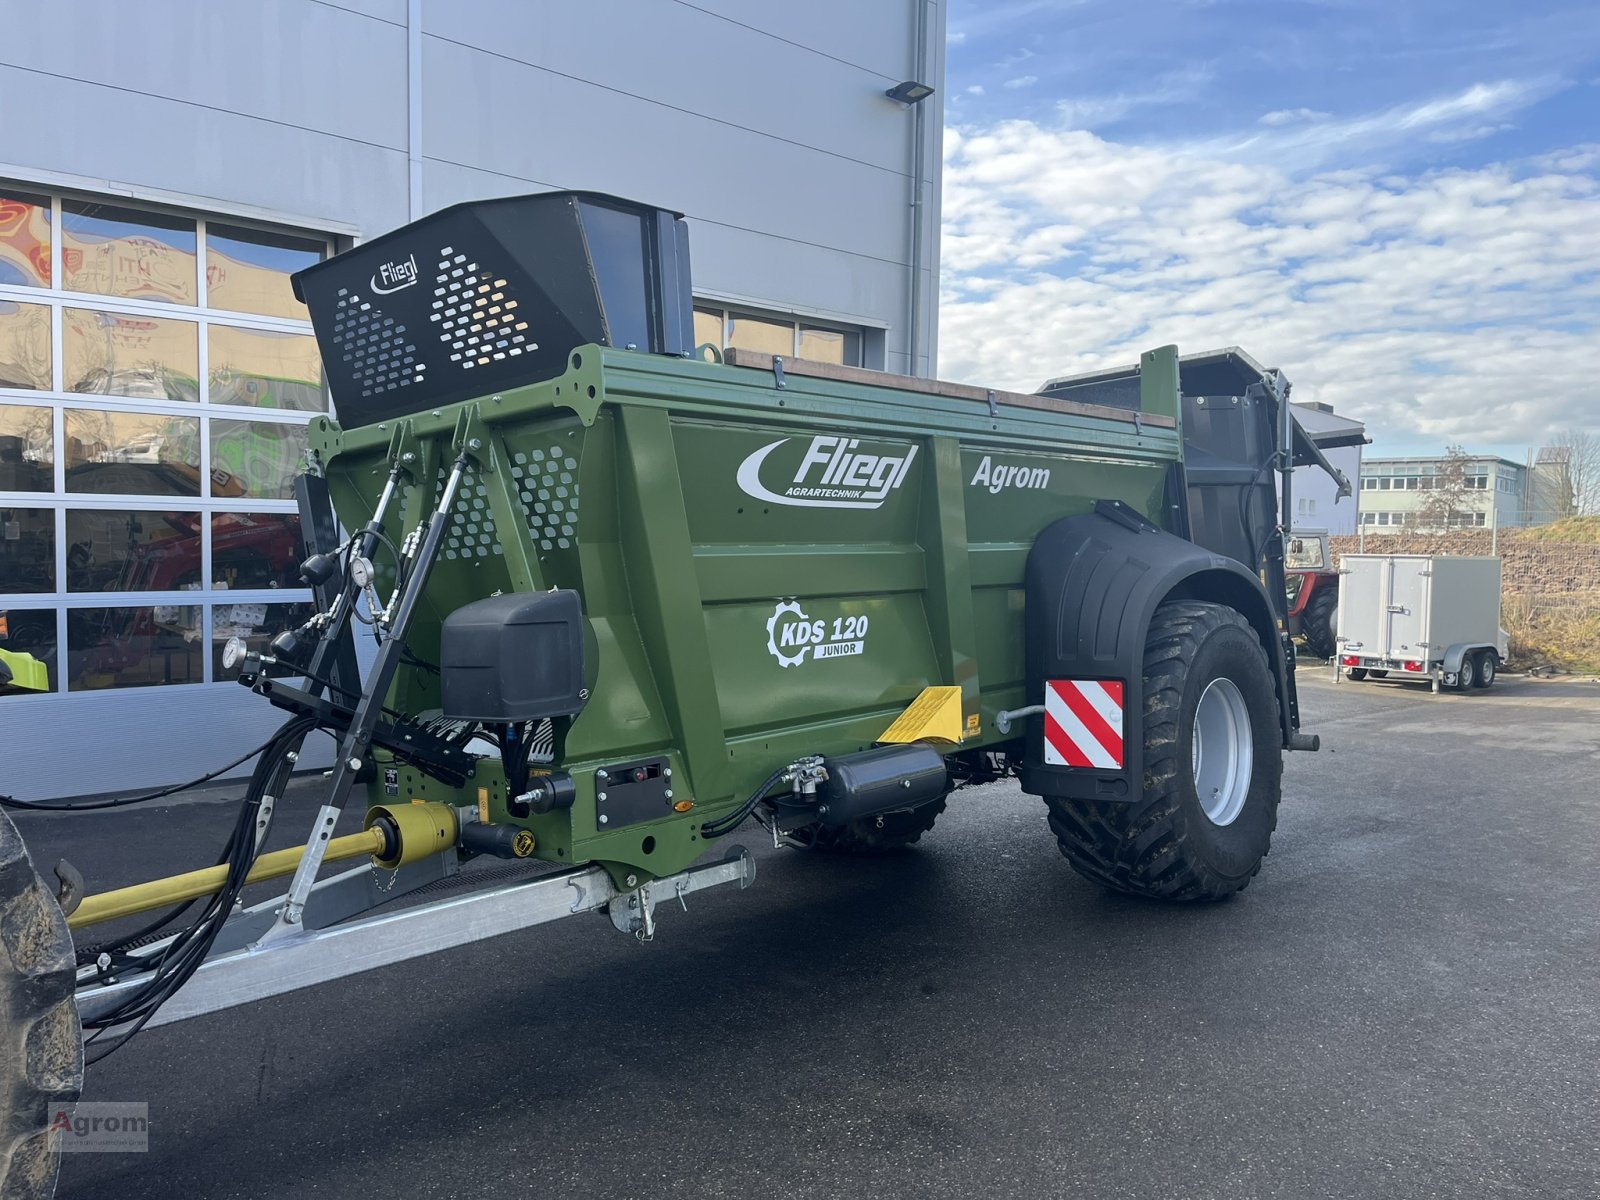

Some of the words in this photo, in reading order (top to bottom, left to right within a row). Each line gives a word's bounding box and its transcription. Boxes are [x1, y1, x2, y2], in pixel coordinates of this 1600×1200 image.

[379, 253, 418, 285] Fliegl
[793, 436, 919, 499] Fliegl
[970, 456, 1051, 494] Agrom
[785, 487, 862, 499] AGRARTECHNIK
[780, 620, 826, 647] KDS
[830, 615, 869, 641] 120
[822, 643, 857, 656] JUNIOR
